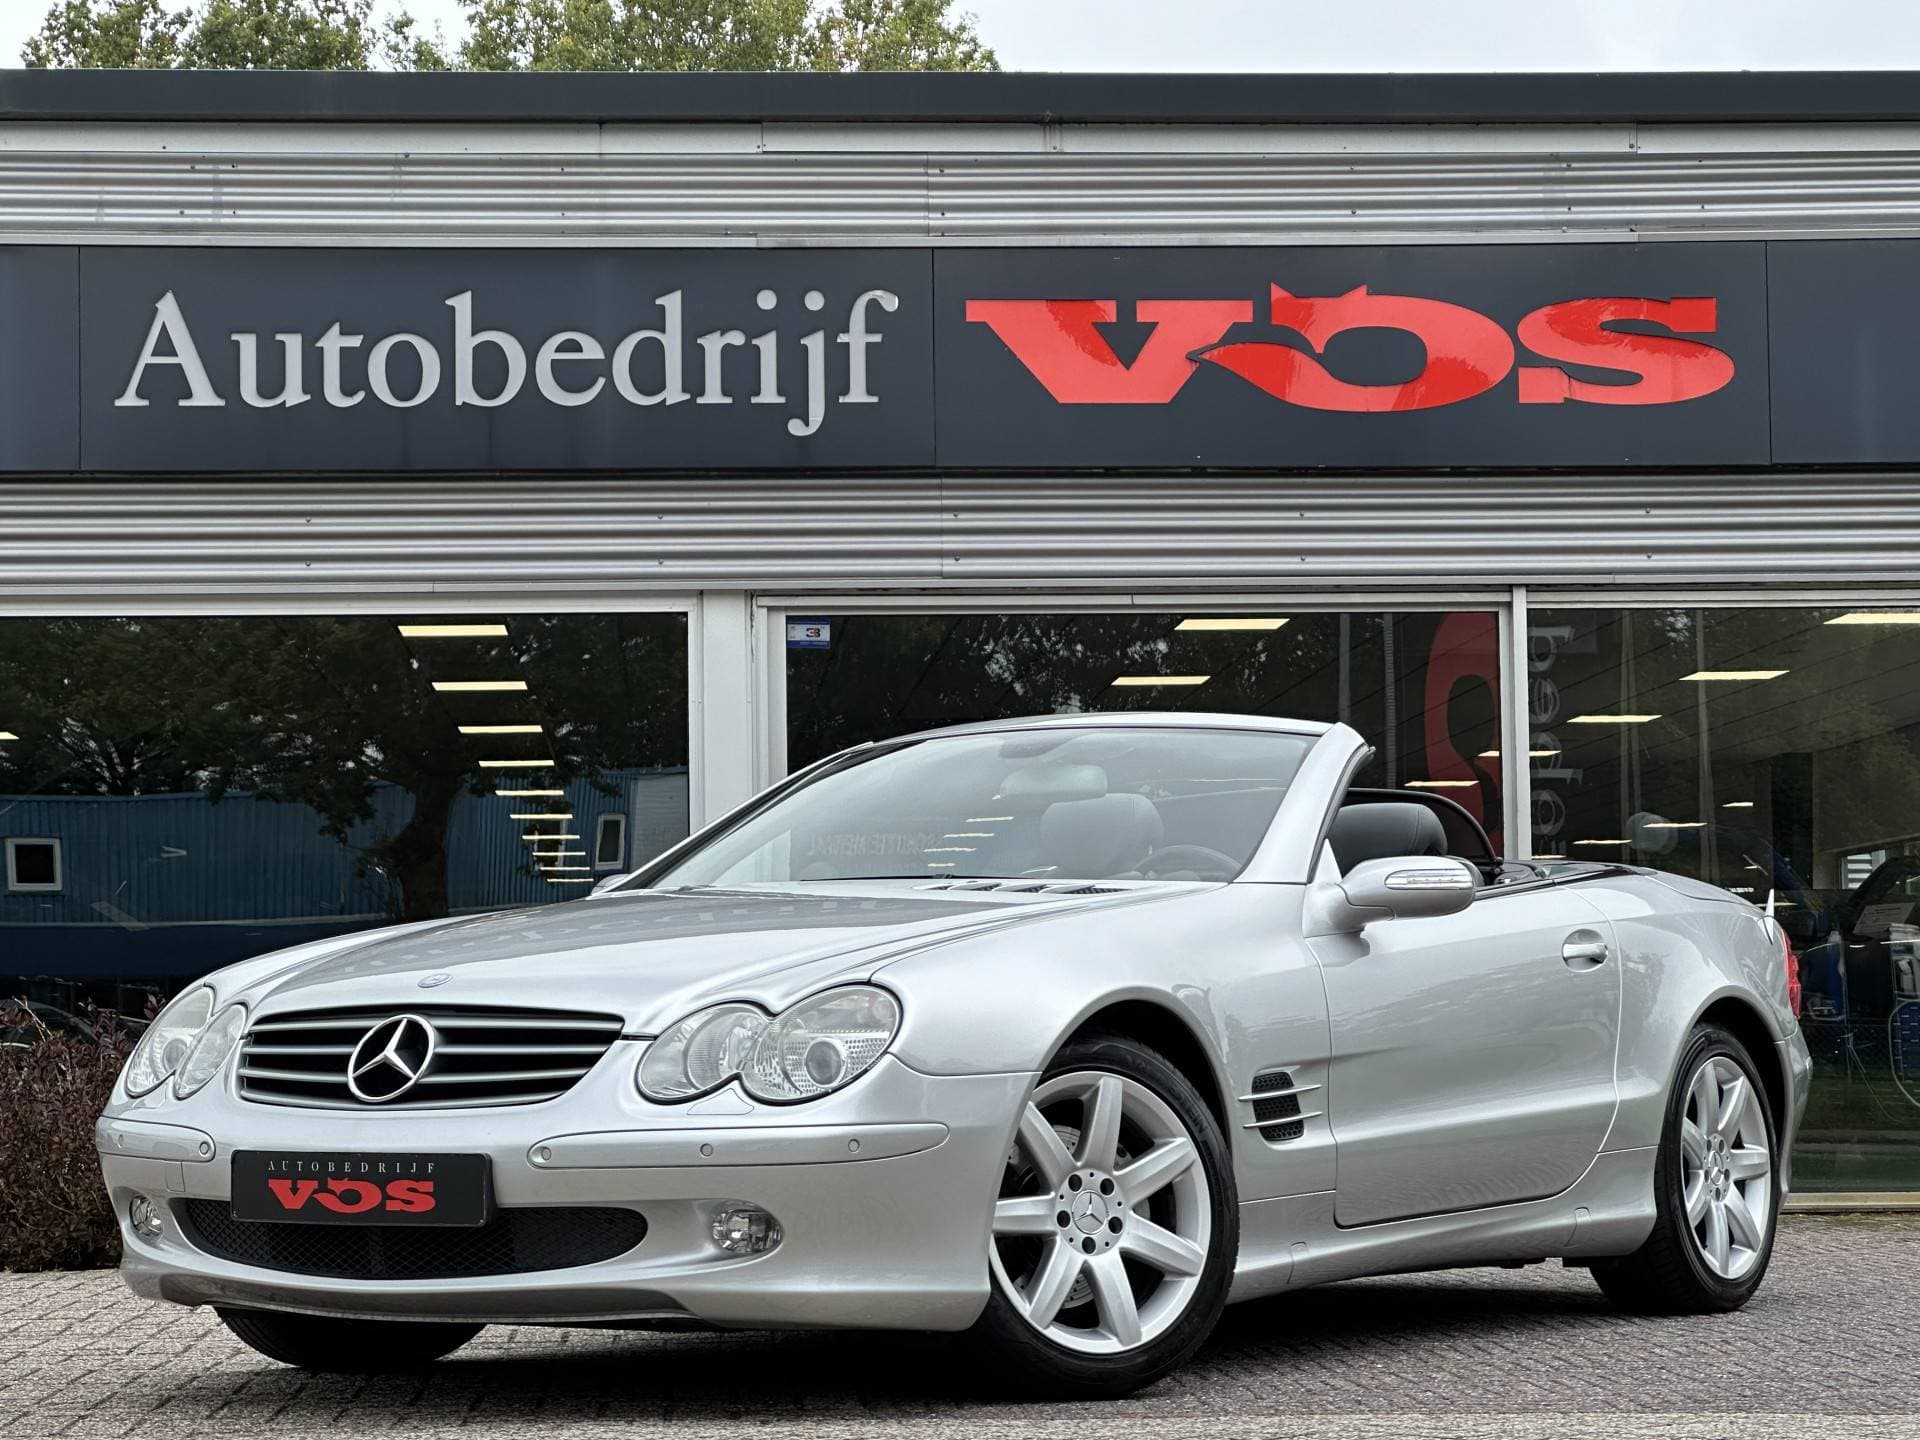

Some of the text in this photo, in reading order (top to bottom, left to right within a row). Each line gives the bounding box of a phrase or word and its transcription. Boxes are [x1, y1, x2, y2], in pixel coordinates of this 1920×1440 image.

[114, 284, 1736, 437] Autobedrijf VOS
[267, 1160, 435, 1174] AUTOBEDRIJF
[267, 1177, 437, 1214] VOS
